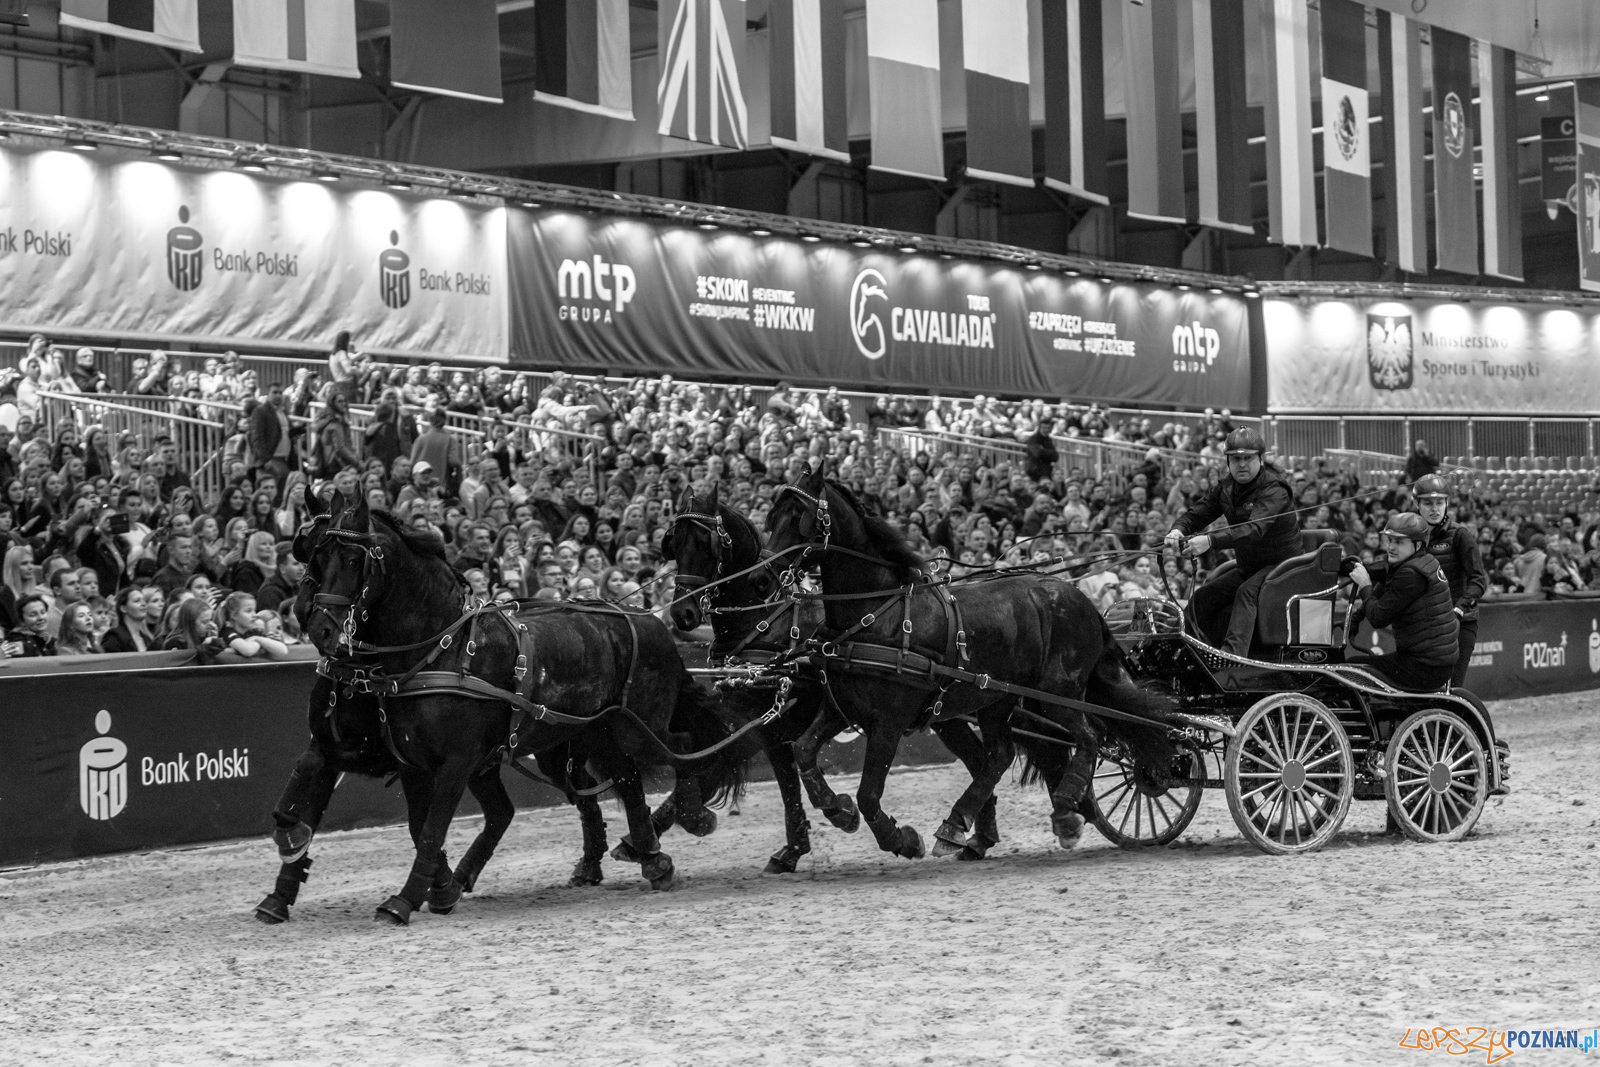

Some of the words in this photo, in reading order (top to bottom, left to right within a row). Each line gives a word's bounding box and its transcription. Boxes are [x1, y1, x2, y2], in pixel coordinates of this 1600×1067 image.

[0, 226, 18, 253] nk
[24, 229, 71, 257] Polski
[214, 247, 252, 273] Bank
[256, 251, 298, 277] Polski
[420, 267, 452, 292] Bank
[455, 271, 491, 296] Polski
[558, 254, 637, 312] mtp
[696, 275, 749, 303] #SKOKI
[752, 287, 796, 305] #EVENTING
[559, 305, 612, 324] GRUPA
[753, 303, 815, 332] #WKKW
[966, 294, 991, 312] TOUR
[891, 306, 995, 349] CAVALIADA
[1029, 311, 1082, 338] #ZAPRZĘGI
[1172, 320, 1220, 366] mtp
[1421, 331, 1508, 349] Ministerstwo
[1172, 359, 1206, 373] GRUPA
[1422, 359, 1468, 378] Sportu
[1472, 360, 1477, 375] i
[1482, 360, 1540, 380] Turystyki
[141, 752, 190, 786] Bank
[196, 748, 249, 781] Polski
